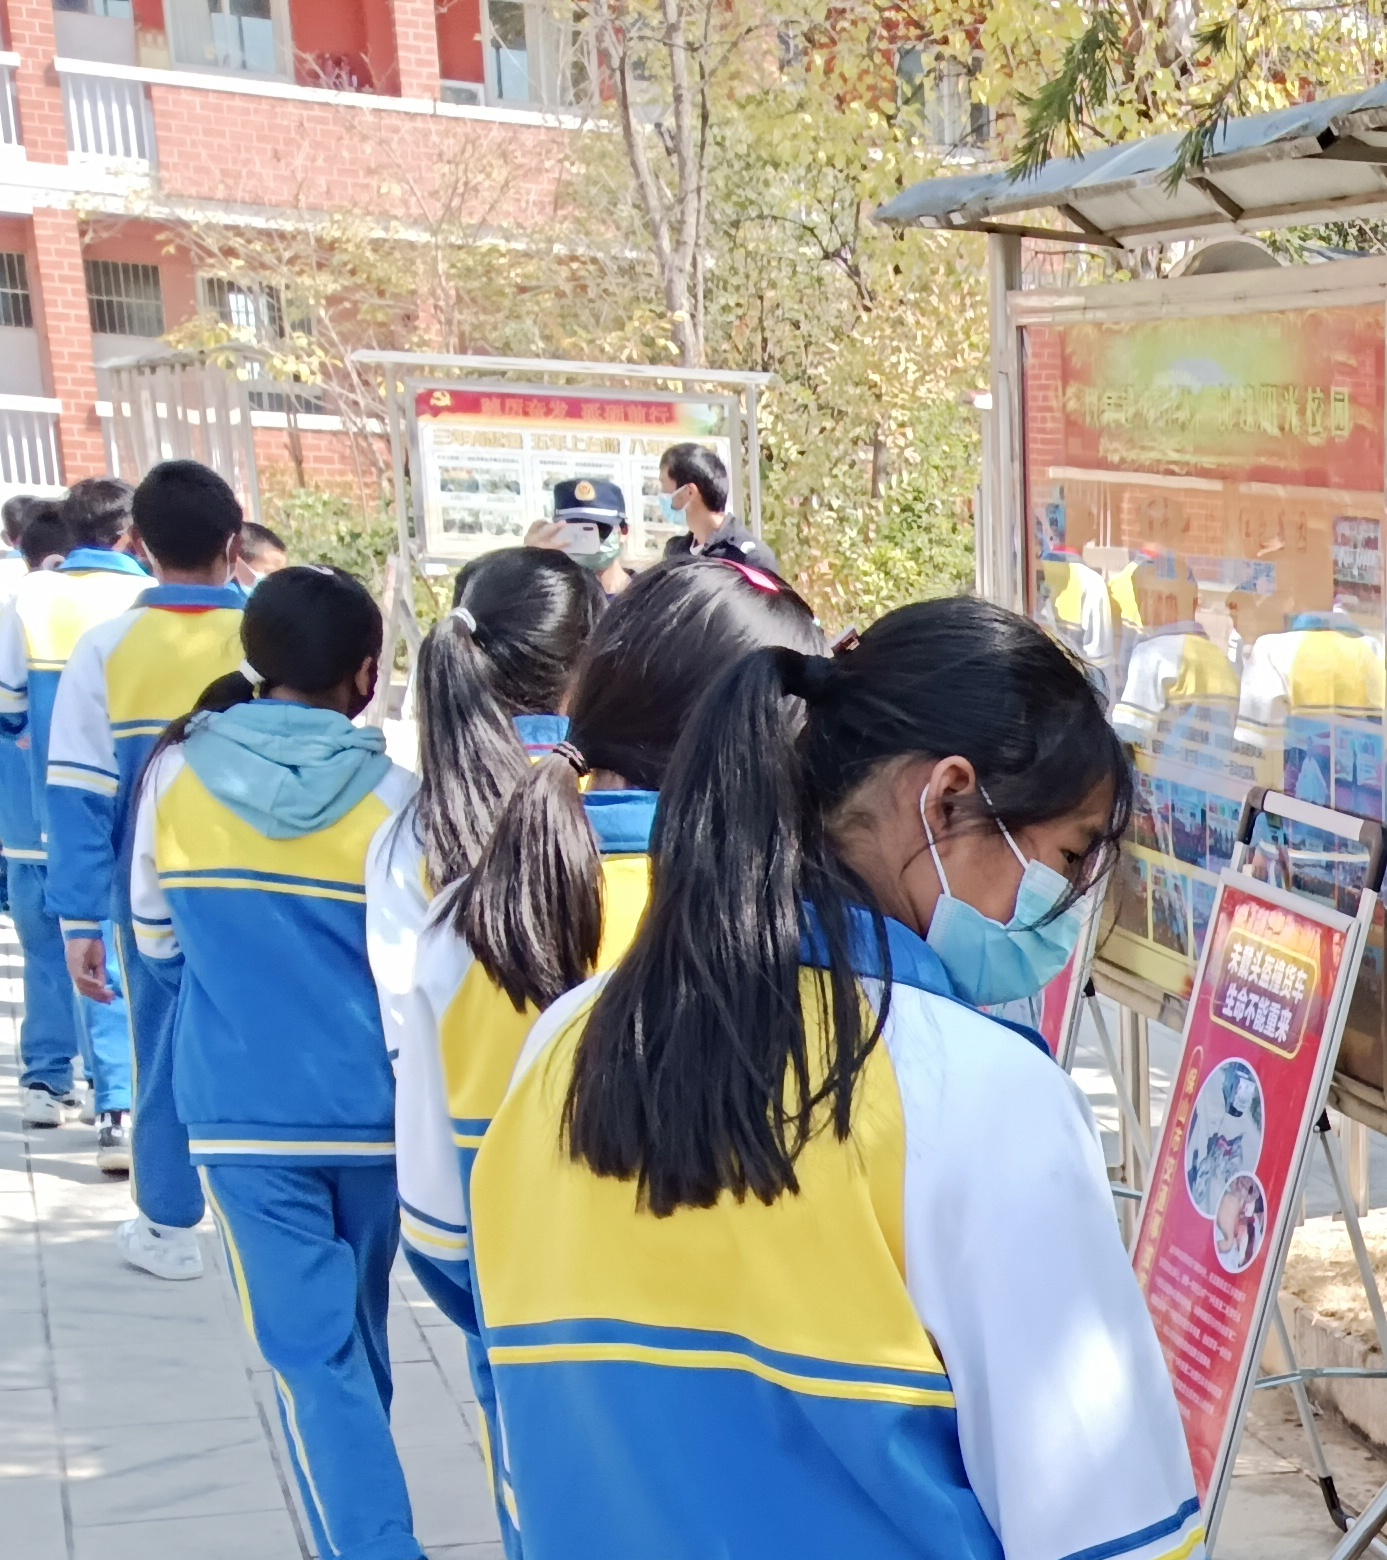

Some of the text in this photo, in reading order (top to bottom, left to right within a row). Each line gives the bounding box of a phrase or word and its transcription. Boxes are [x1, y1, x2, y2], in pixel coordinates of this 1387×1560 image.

[1221, 983, 1292, 1044] 生命不能重来
